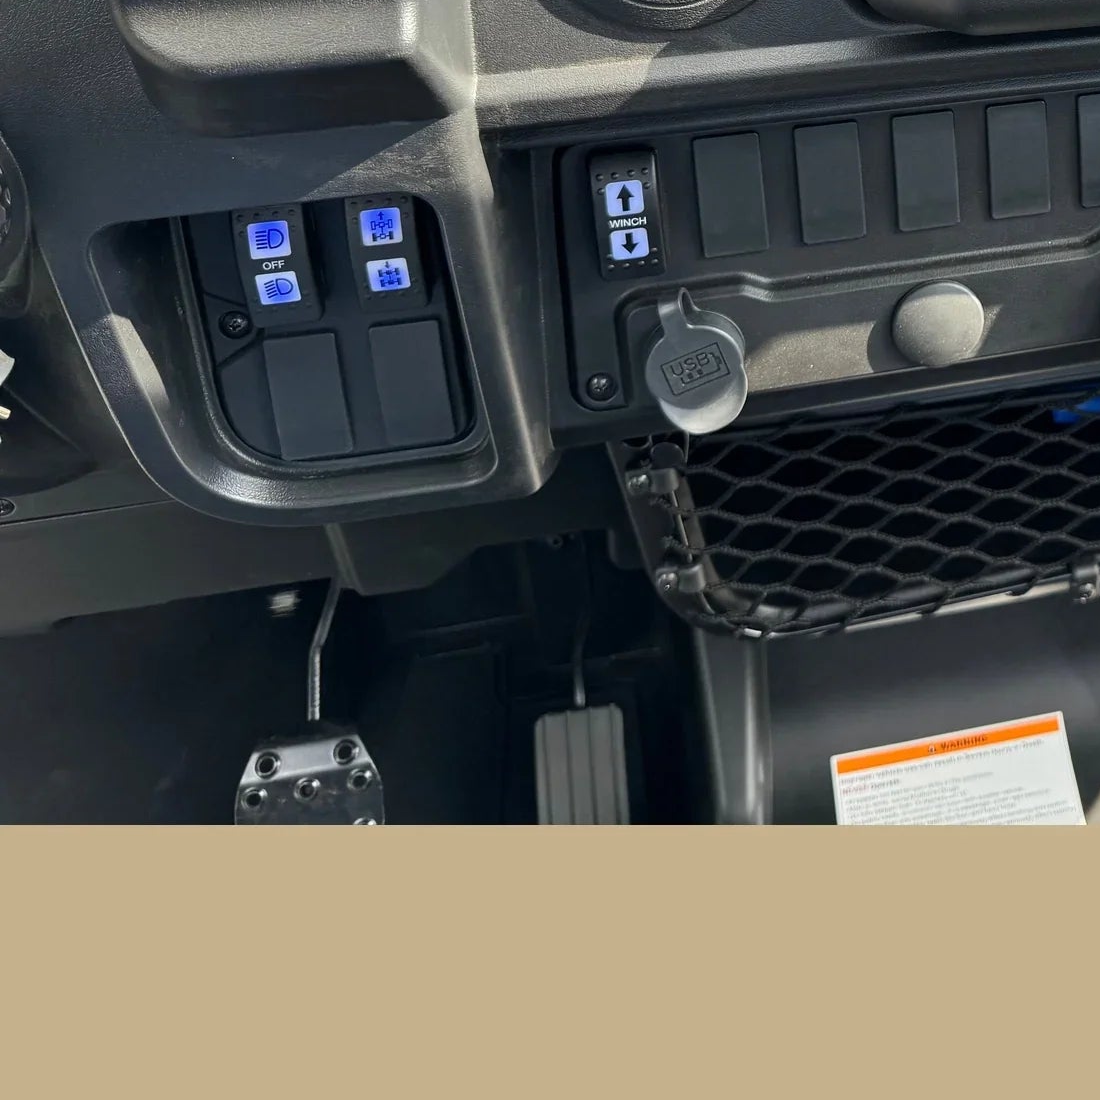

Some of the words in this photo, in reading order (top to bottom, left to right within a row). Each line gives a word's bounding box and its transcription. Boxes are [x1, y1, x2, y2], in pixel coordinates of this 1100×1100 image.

[608, 215, 648, 229] WINCH
[262, 259, 286, 271] OFF
[669, 351, 711, 378] USB
[940, 733, 989, 751] WARNING
